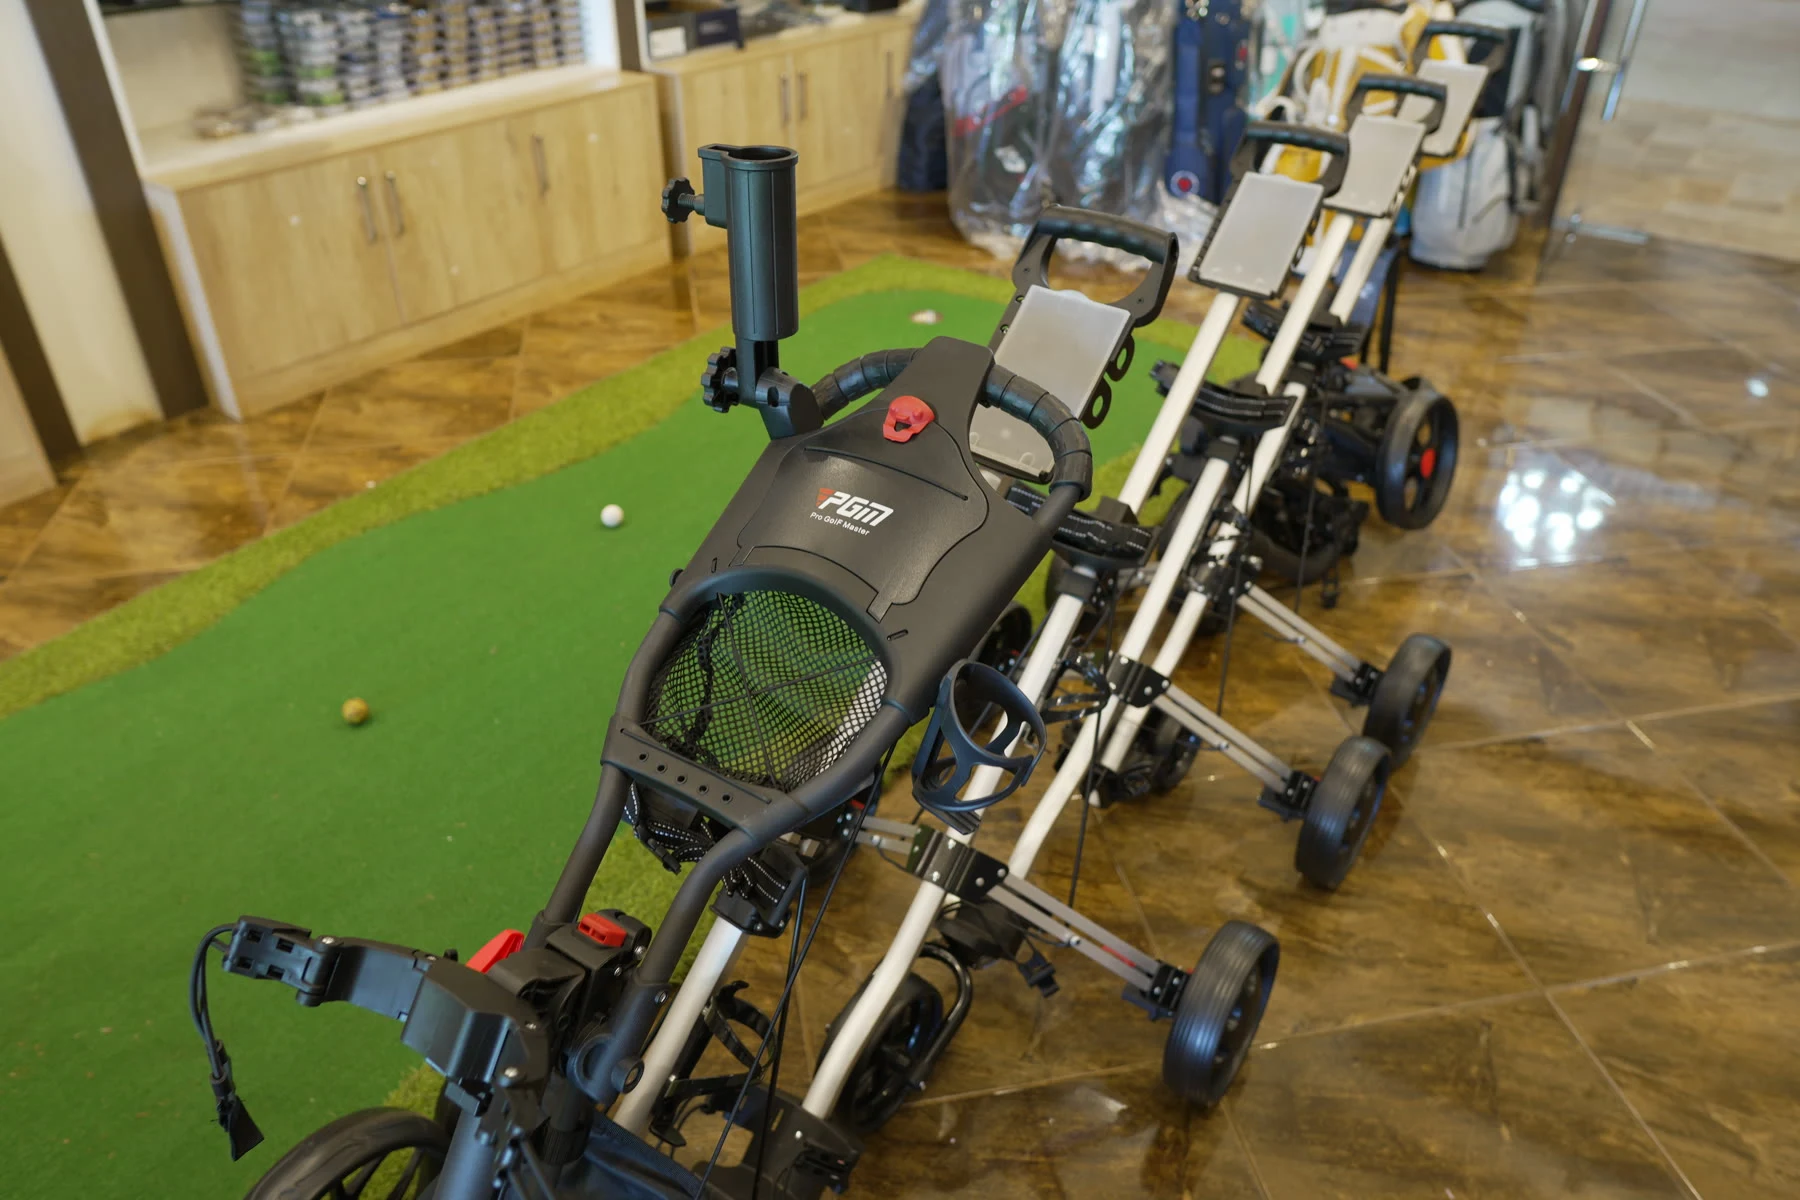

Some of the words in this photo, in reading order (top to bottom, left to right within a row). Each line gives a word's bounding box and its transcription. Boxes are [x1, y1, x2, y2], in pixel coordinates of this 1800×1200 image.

[809, 511, 823, 521] Pro
[842, 520, 870, 536] Master
[818, 490, 894, 527] PGM
